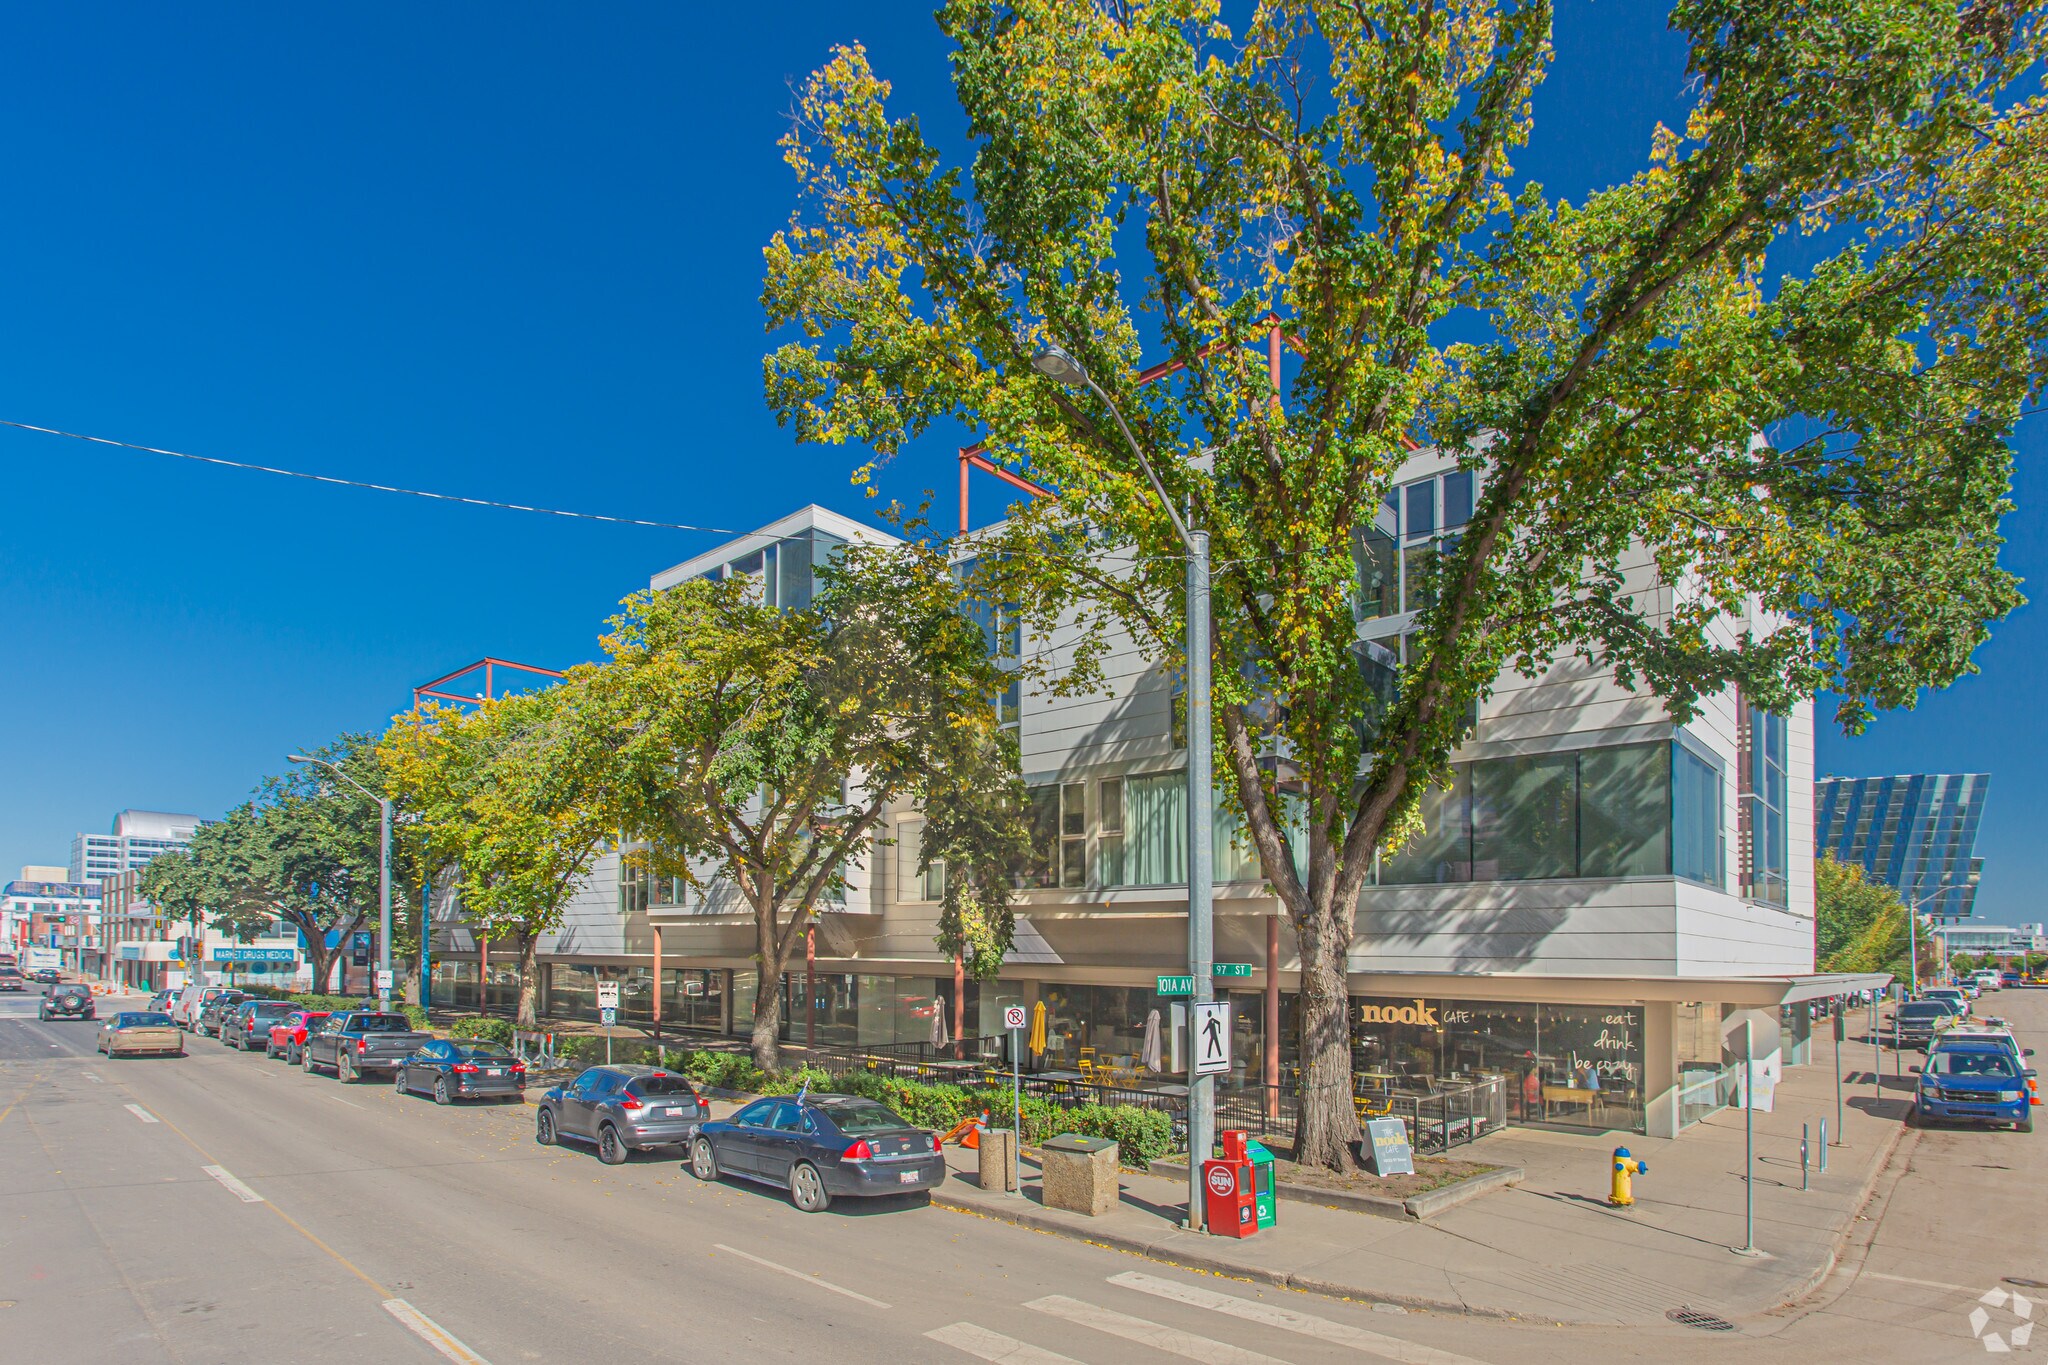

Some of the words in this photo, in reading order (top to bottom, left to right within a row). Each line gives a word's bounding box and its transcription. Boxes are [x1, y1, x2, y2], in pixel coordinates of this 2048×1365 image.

[215, 950, 242, 959] MARKET
[243, 951, 265, 959] DRUGS
[266, 951, 292, 960] MEDICAL
[1216, 965, 1227, 975] 97
[1235, 965, 1245, 975] ST
[1159, 978, 1178, 992] 101A
[1180, 978, 1193, 992] AV
[1361, 998, 1440, 1027] nook
[1443, 1010, 1470, 1024] CAFE
[1593, 1029, 1638, 1052] drink.
[1572, 1050, 1593, 1070] be
[1596, 1059, 1638, 1081] cozy.
[1375, 1131, 1406, 1147] nook
[1211, 1175, 1231, 1187] SUN
